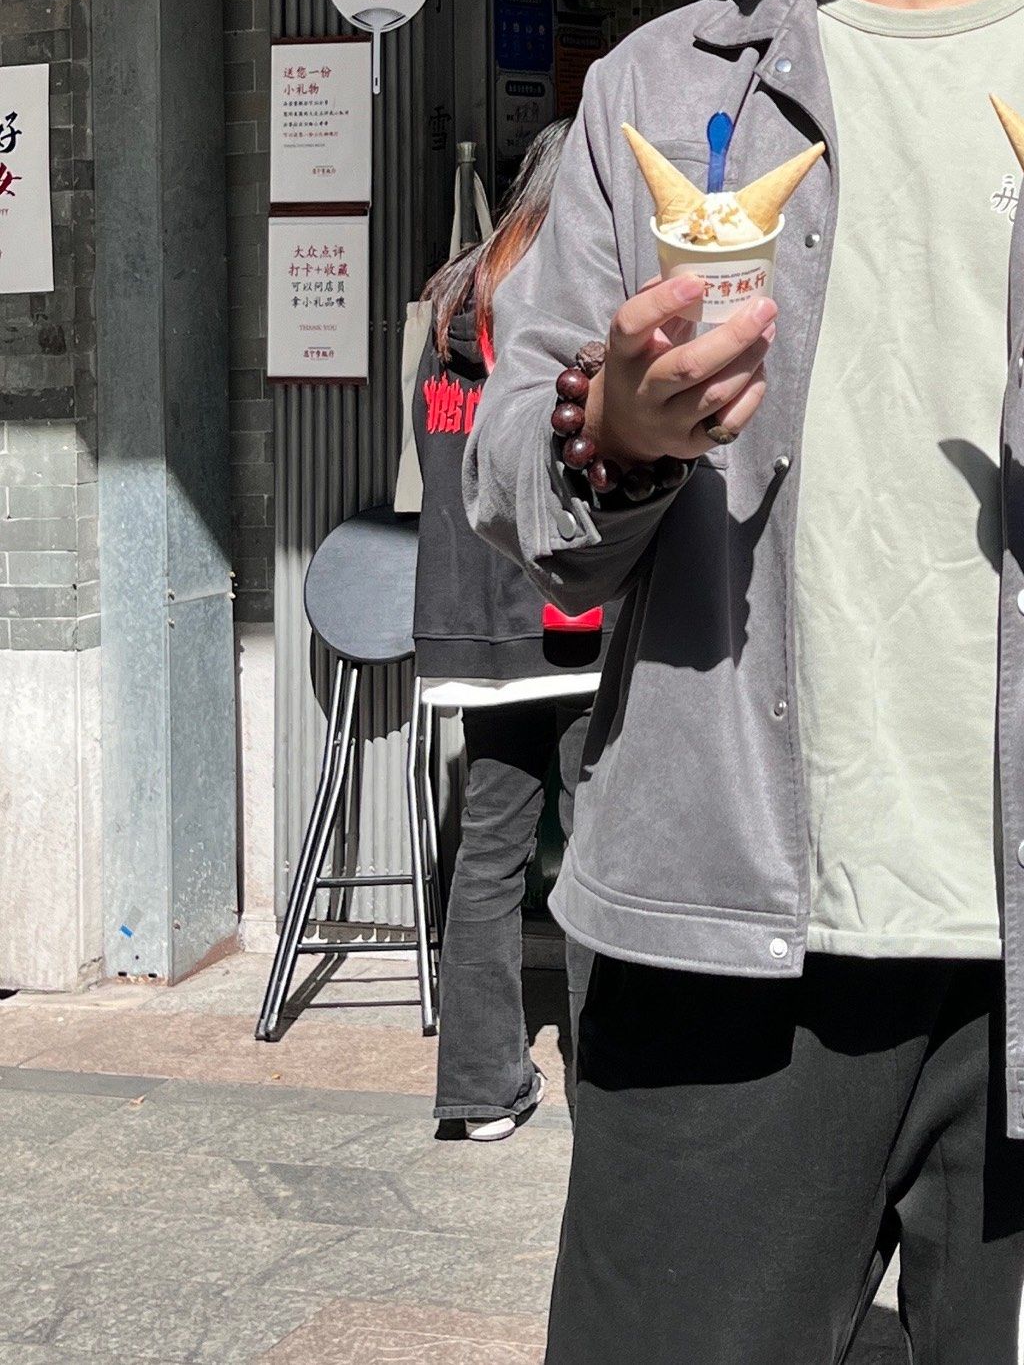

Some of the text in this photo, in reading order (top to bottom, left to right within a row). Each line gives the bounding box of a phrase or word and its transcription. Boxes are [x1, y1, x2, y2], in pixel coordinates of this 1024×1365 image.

[283, 66, 332, 79] 送您一份
[283, 83, 320, 95] 小礼物
[294, 245, 345, 258] 大众点评
[289, 263, 349, 277] 打卡+收藏
